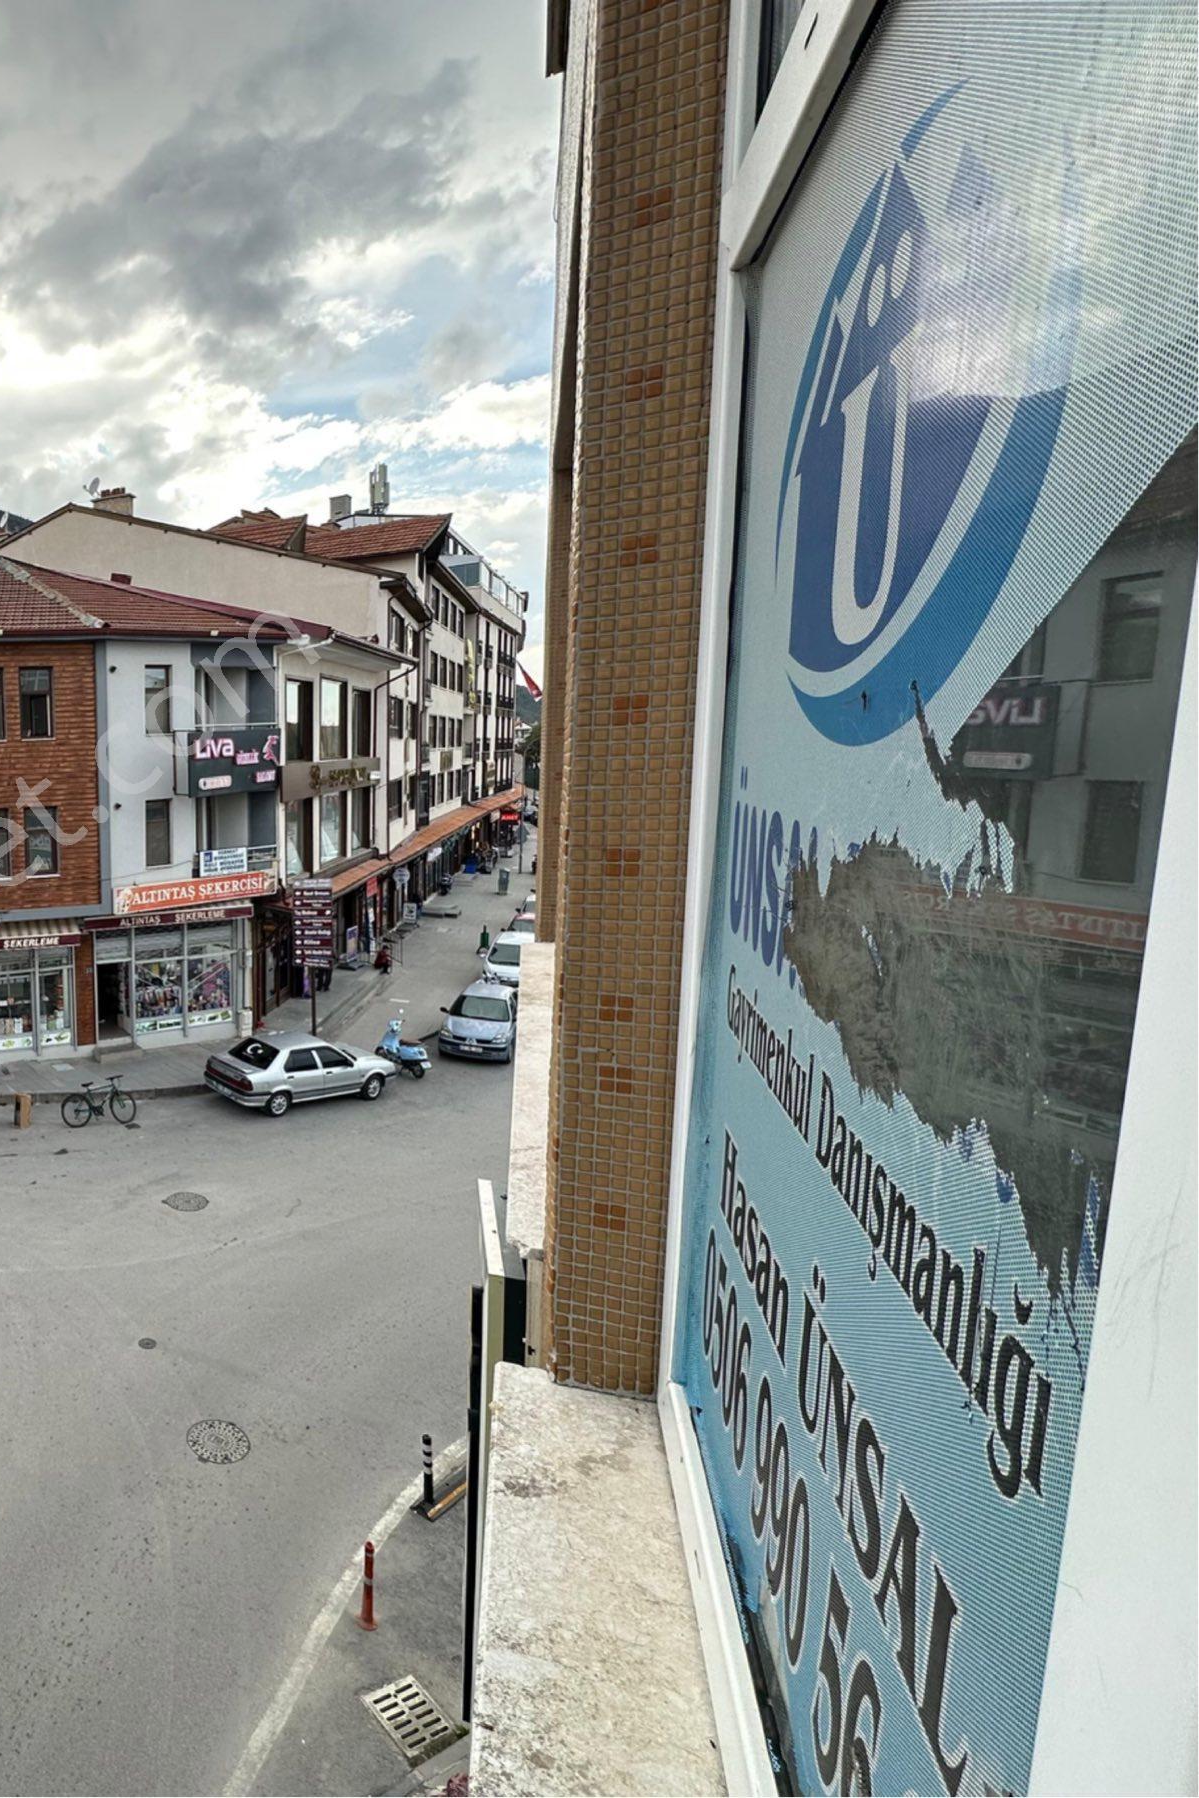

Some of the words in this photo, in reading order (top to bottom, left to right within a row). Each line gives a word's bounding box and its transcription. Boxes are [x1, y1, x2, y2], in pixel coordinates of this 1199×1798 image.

[132, 885, 196, 905] ALTINTAŞ
[198, 875, 264, 899] ŞEKERCİSİ
[703, 1228, 751, 1470] 0506
[751, 1374, 810, 1667] 990
[719, 1129, 790, 1368] Hasan
[801, 1263, 969, 1797] ÜNSAL
[727, 964, 815, 1143] Gayrimenkul
[815, 1072, 1051, 1499] Danışmanlığı
